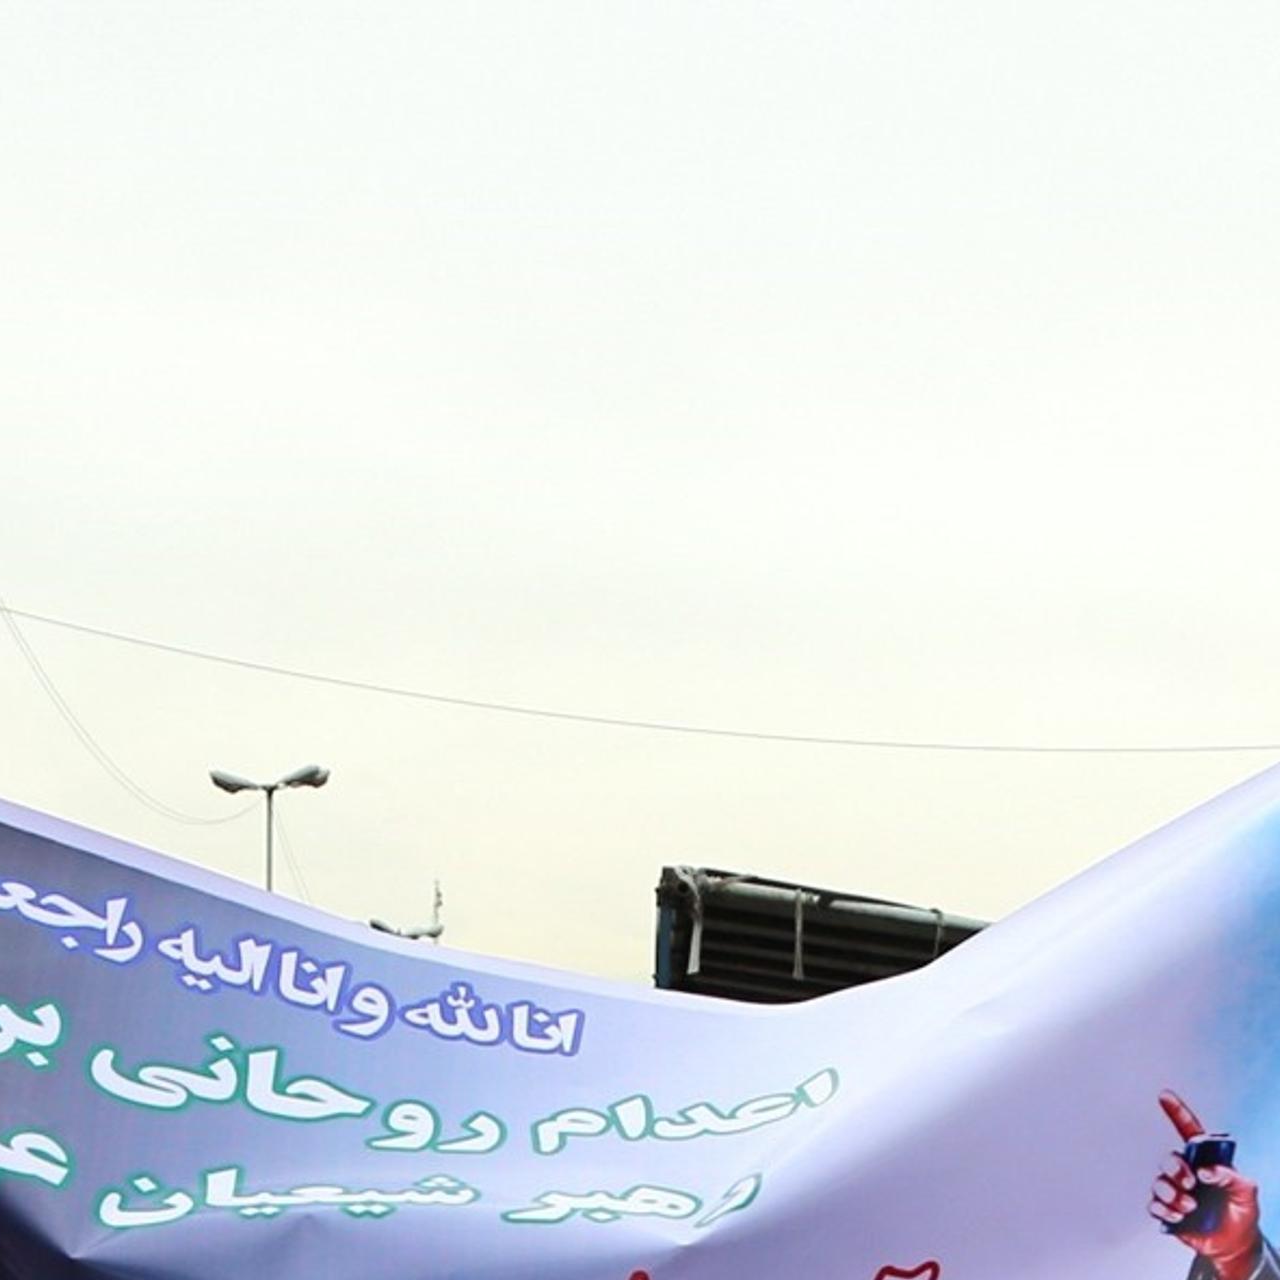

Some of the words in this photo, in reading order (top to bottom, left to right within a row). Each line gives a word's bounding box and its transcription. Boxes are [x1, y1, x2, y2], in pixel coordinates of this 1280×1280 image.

[88, 1034, 508, 1155] روحانی
[530, 1067, 841, 1156] اعدام
[97, 1164, 482, 1230] شیعیان
[500, 1170, 762, 1230] رهبر
